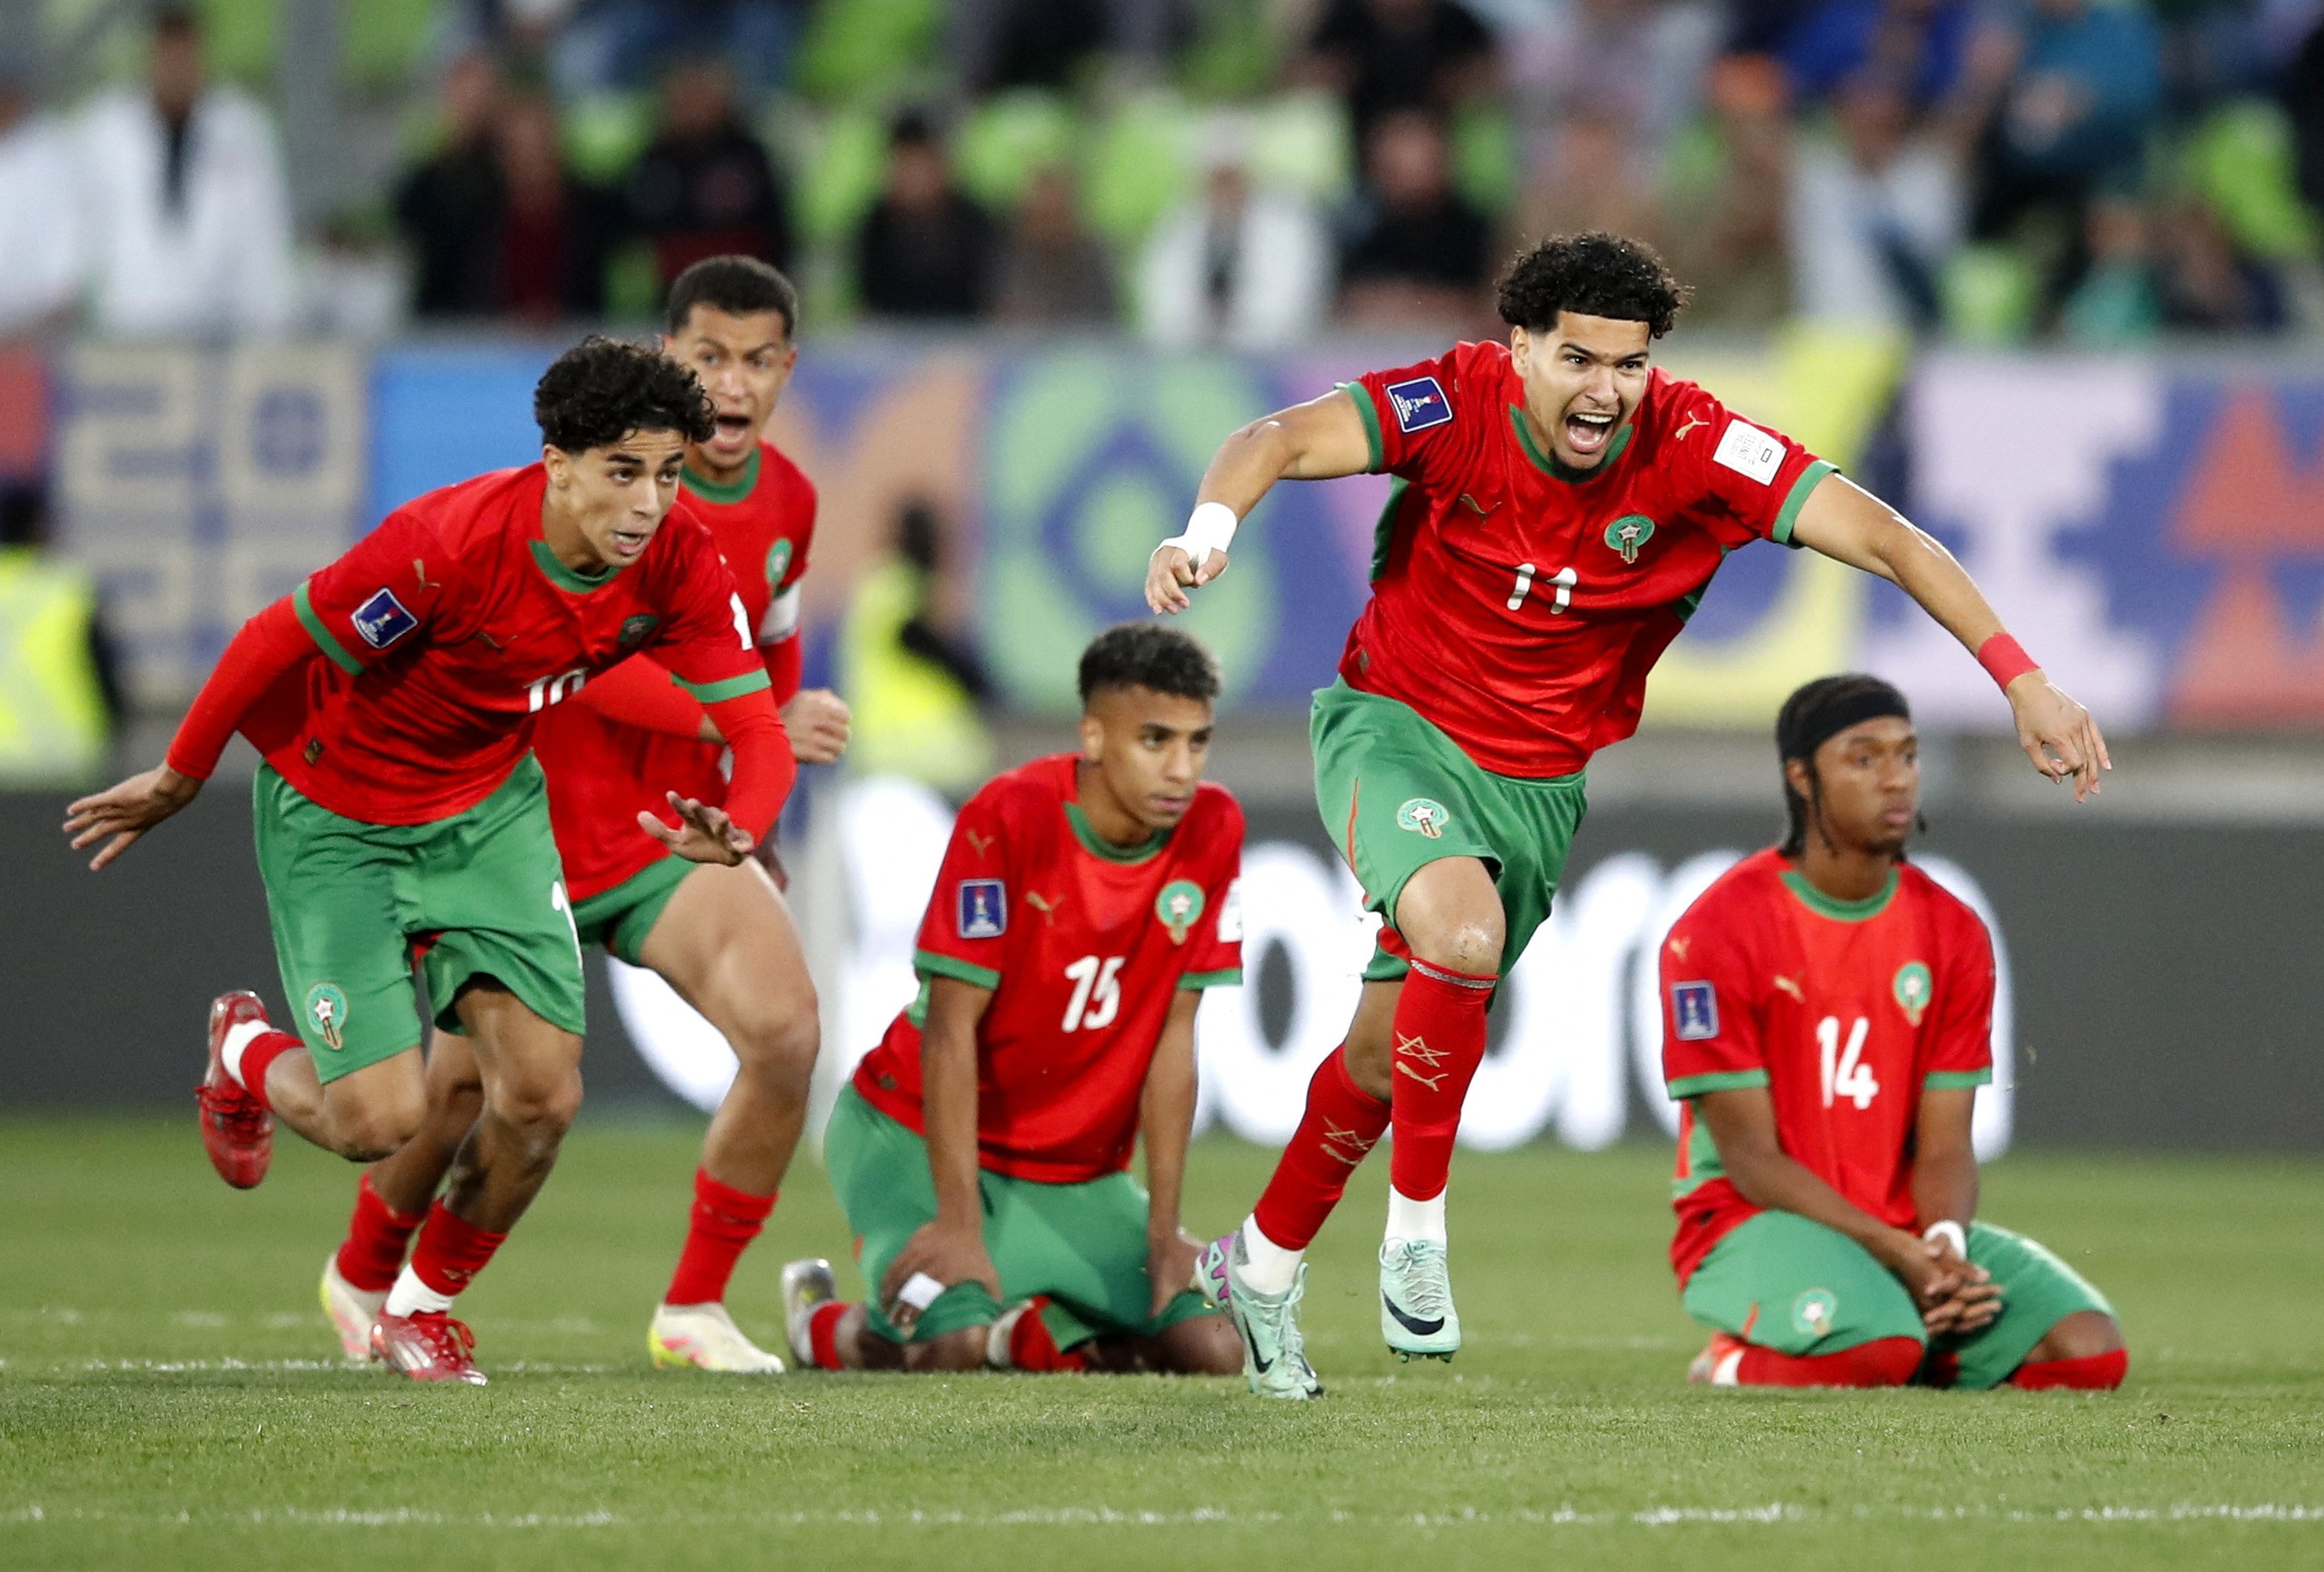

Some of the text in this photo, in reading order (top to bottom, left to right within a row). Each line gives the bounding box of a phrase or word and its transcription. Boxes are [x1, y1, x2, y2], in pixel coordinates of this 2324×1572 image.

[1507, 563, 1578, 615] 11
[1061, 954, 1126, 1034] 15
[1816, 1015, 1880, 1111] 14
